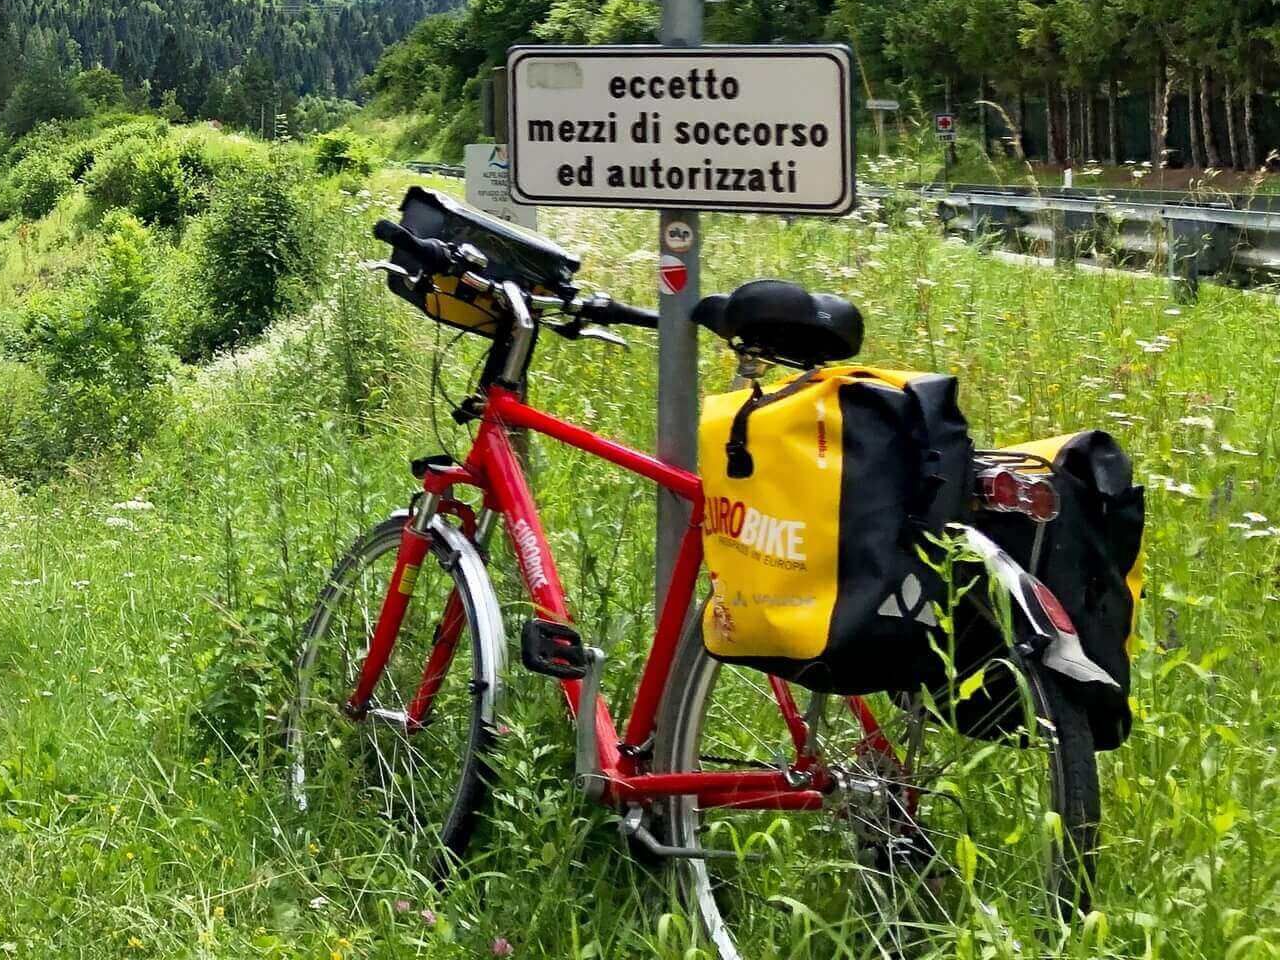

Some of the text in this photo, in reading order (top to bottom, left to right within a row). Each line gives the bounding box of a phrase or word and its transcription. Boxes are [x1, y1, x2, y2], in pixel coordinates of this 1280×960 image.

[607, 68, 740, 100] eccetto
[527, 111, 829, 148] mezzi di soccorso
[557, 155, 797, 194] ed autorizzati
[763, 555, 808, 572] EUROPA
